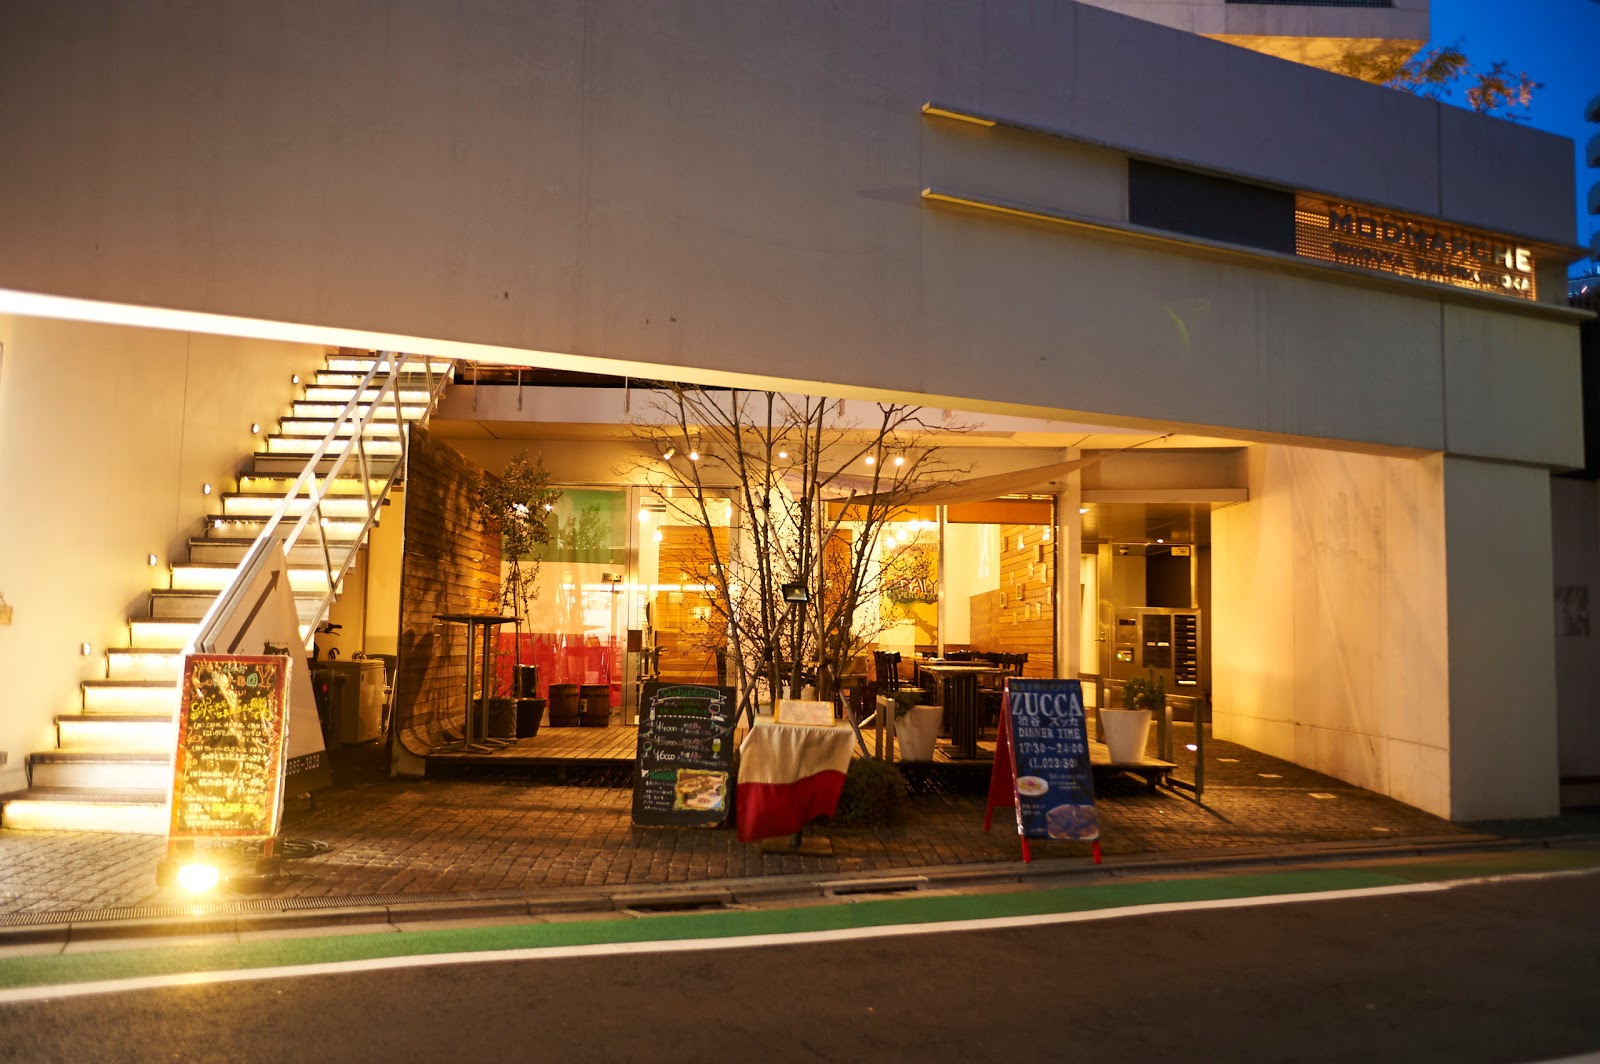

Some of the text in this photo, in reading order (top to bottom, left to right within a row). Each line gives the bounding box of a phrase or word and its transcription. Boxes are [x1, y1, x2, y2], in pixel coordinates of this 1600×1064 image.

[1330, 210, 1532, 273] MODMARCHE
[1010, 692, 1083, 717] ZUCCA
[1018, 727, 1081, 740] DINNER TIME
